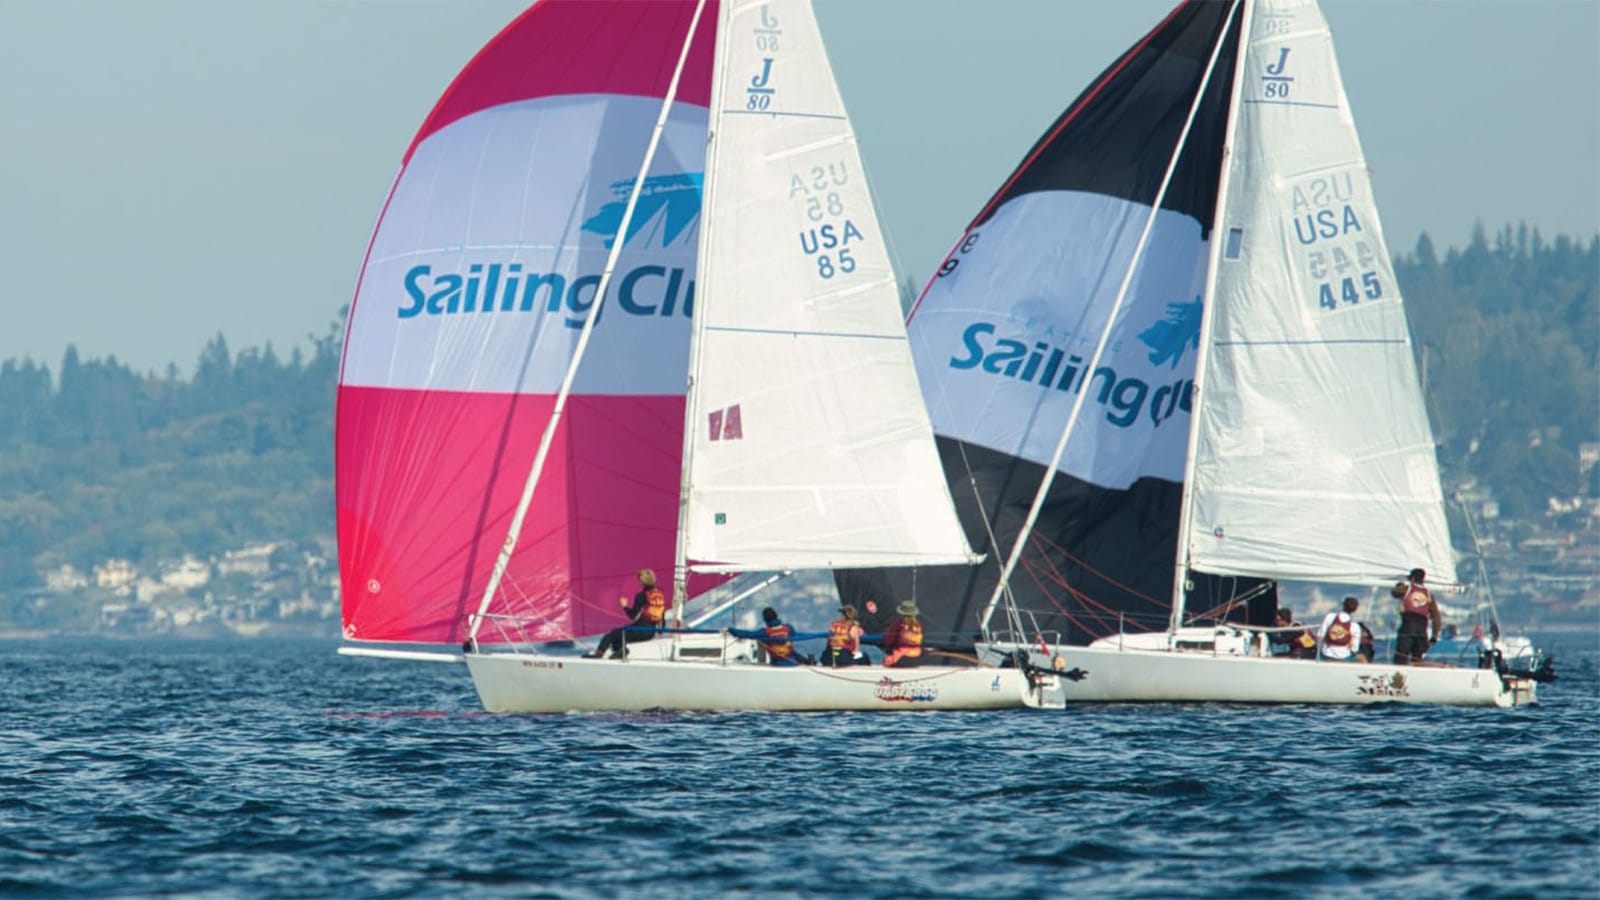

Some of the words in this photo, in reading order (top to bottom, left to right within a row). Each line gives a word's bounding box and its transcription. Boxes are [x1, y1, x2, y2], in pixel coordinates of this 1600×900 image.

[751, 57, 774, 88] J
[1265, 47, 1292, 75] J
[746, 94, 771, 110] 80
[1264, 82, 1290, 98] 80
[799, 219, 864, 255] USA
[1293, 204, 1363, 245] USA
[817, 248, 856, 279] 85
[397, 263, 605, 330] Sailing
[1318, 271, 1383, 311] 445
[949, 322, 1149, 429] Sailing
